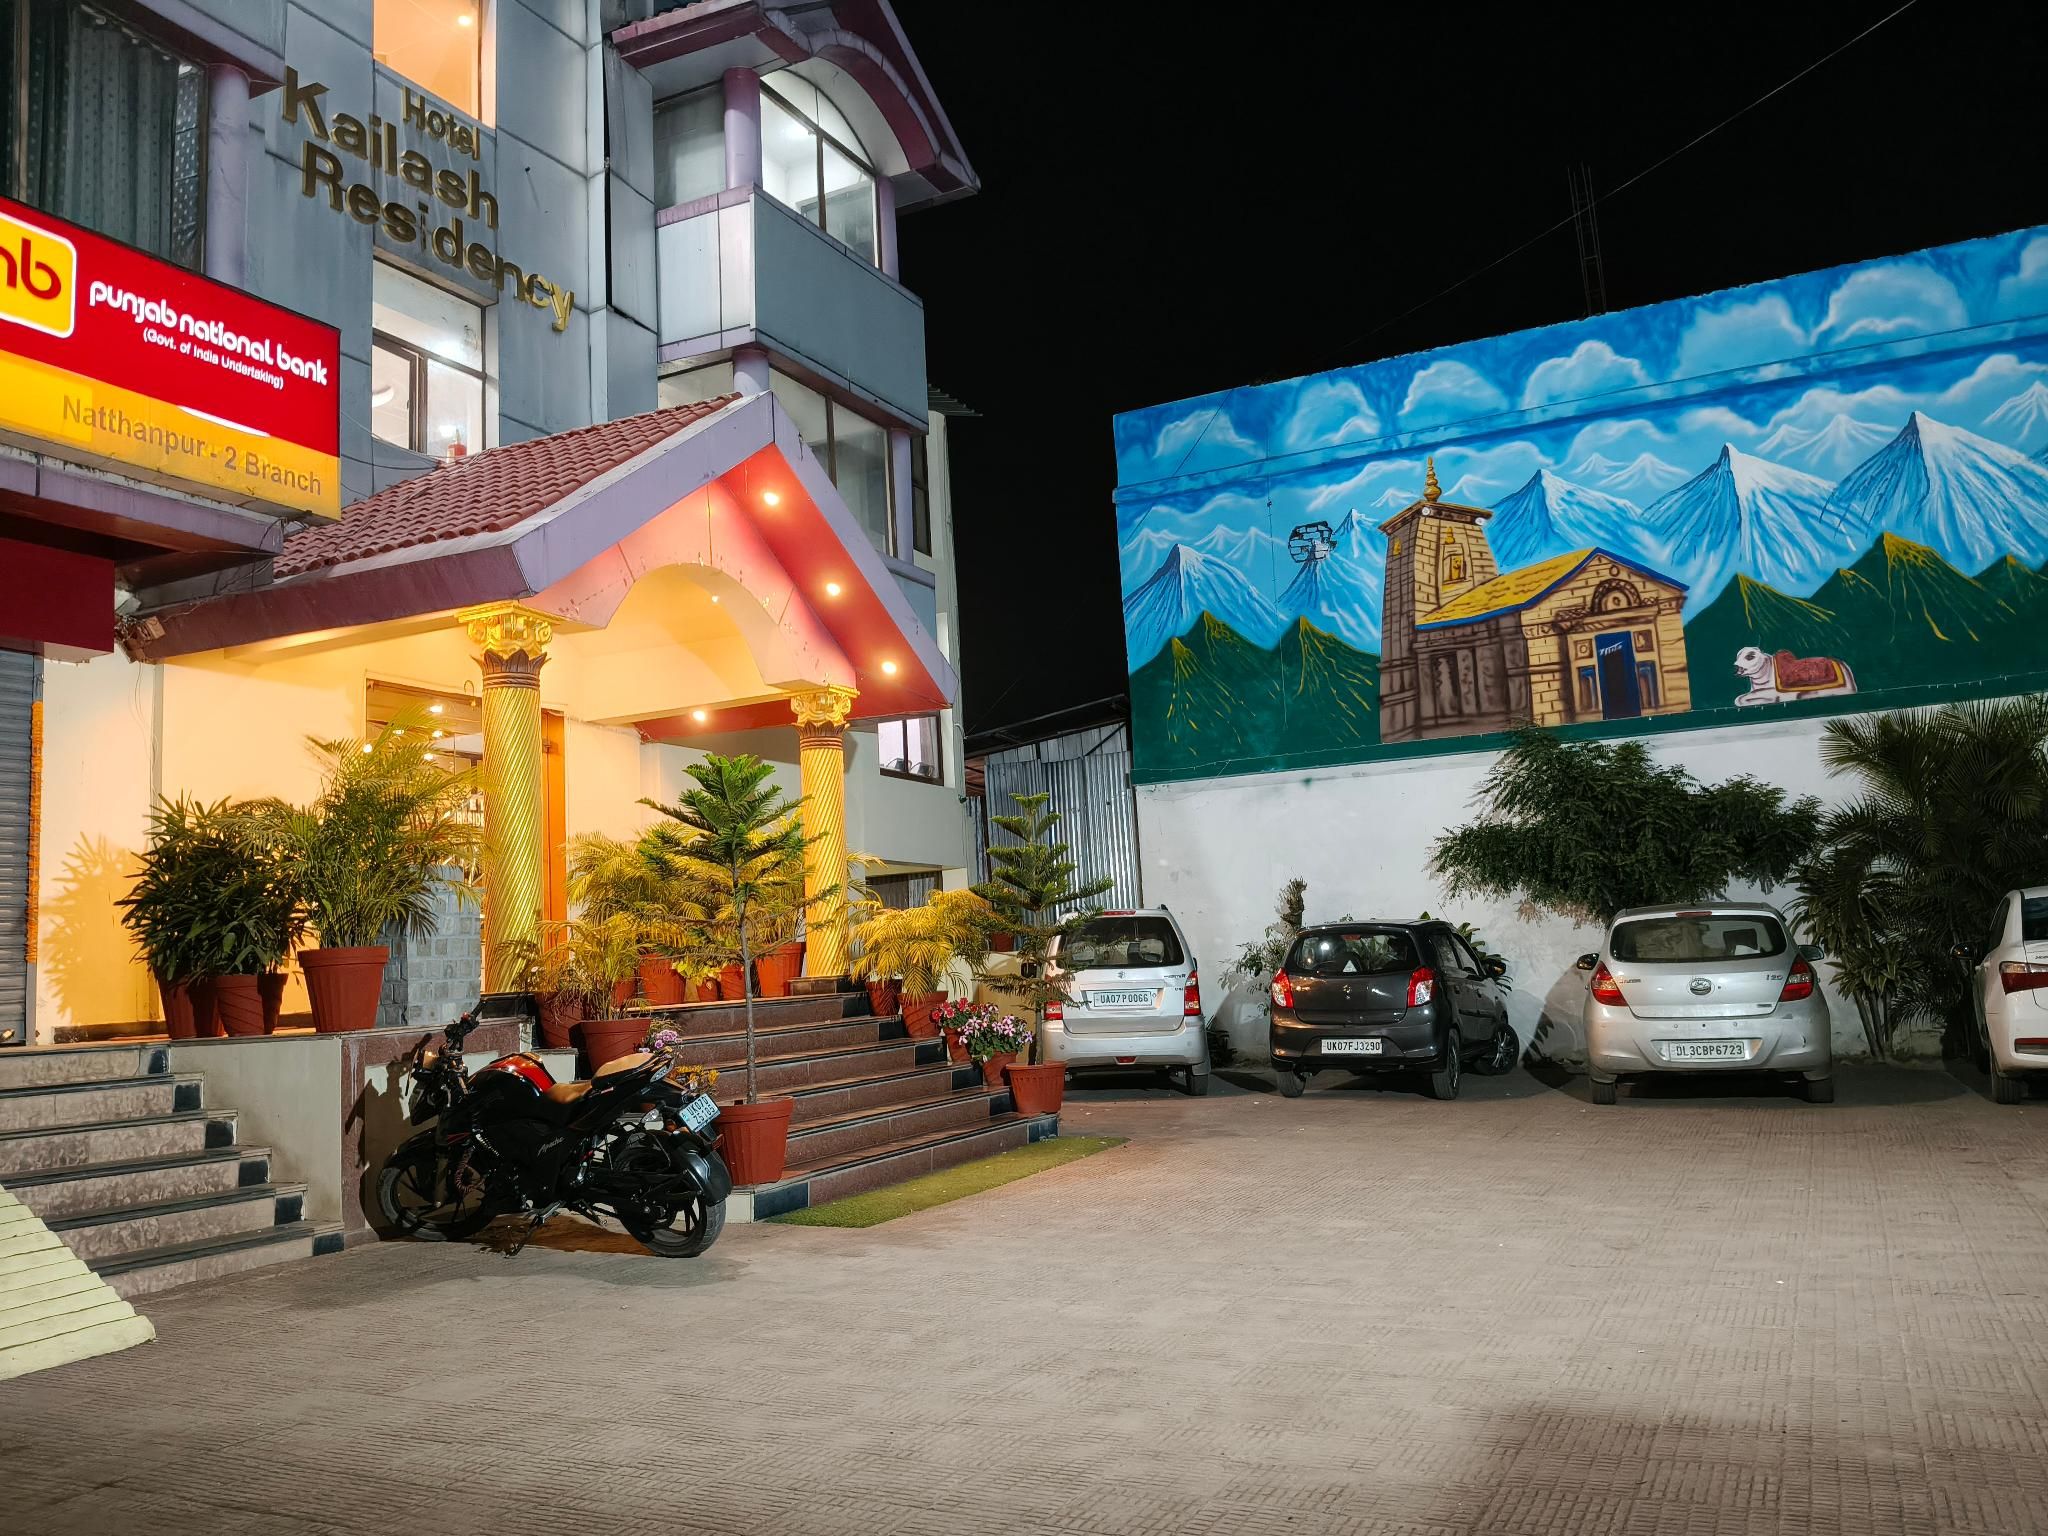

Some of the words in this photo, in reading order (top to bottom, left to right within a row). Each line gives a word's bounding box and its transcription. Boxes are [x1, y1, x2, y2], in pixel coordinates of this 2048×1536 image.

[282, 66, 499, 231] Kailash
[402, 86, 480, 160] Hotel
[302, 140, 575, 332] Residency
[89, 280, 178, 329] punjab
[179, 314, 275, 366] national
[276, 343, 328, 386] bank
[143, 327, 177, 350] (Govt.
[180, 342, 192, 355] of
[193, 345, 219, 365] India
[220, 354, 285, 390] Undertaking)
[224, 446, 237, 471] 2
[246, 451, 322, 496] Branch
[1326, 1041, 1380, 1051] UK07FJ3290
[1676, 1045, 1742, 1056] DL3CBP6723
